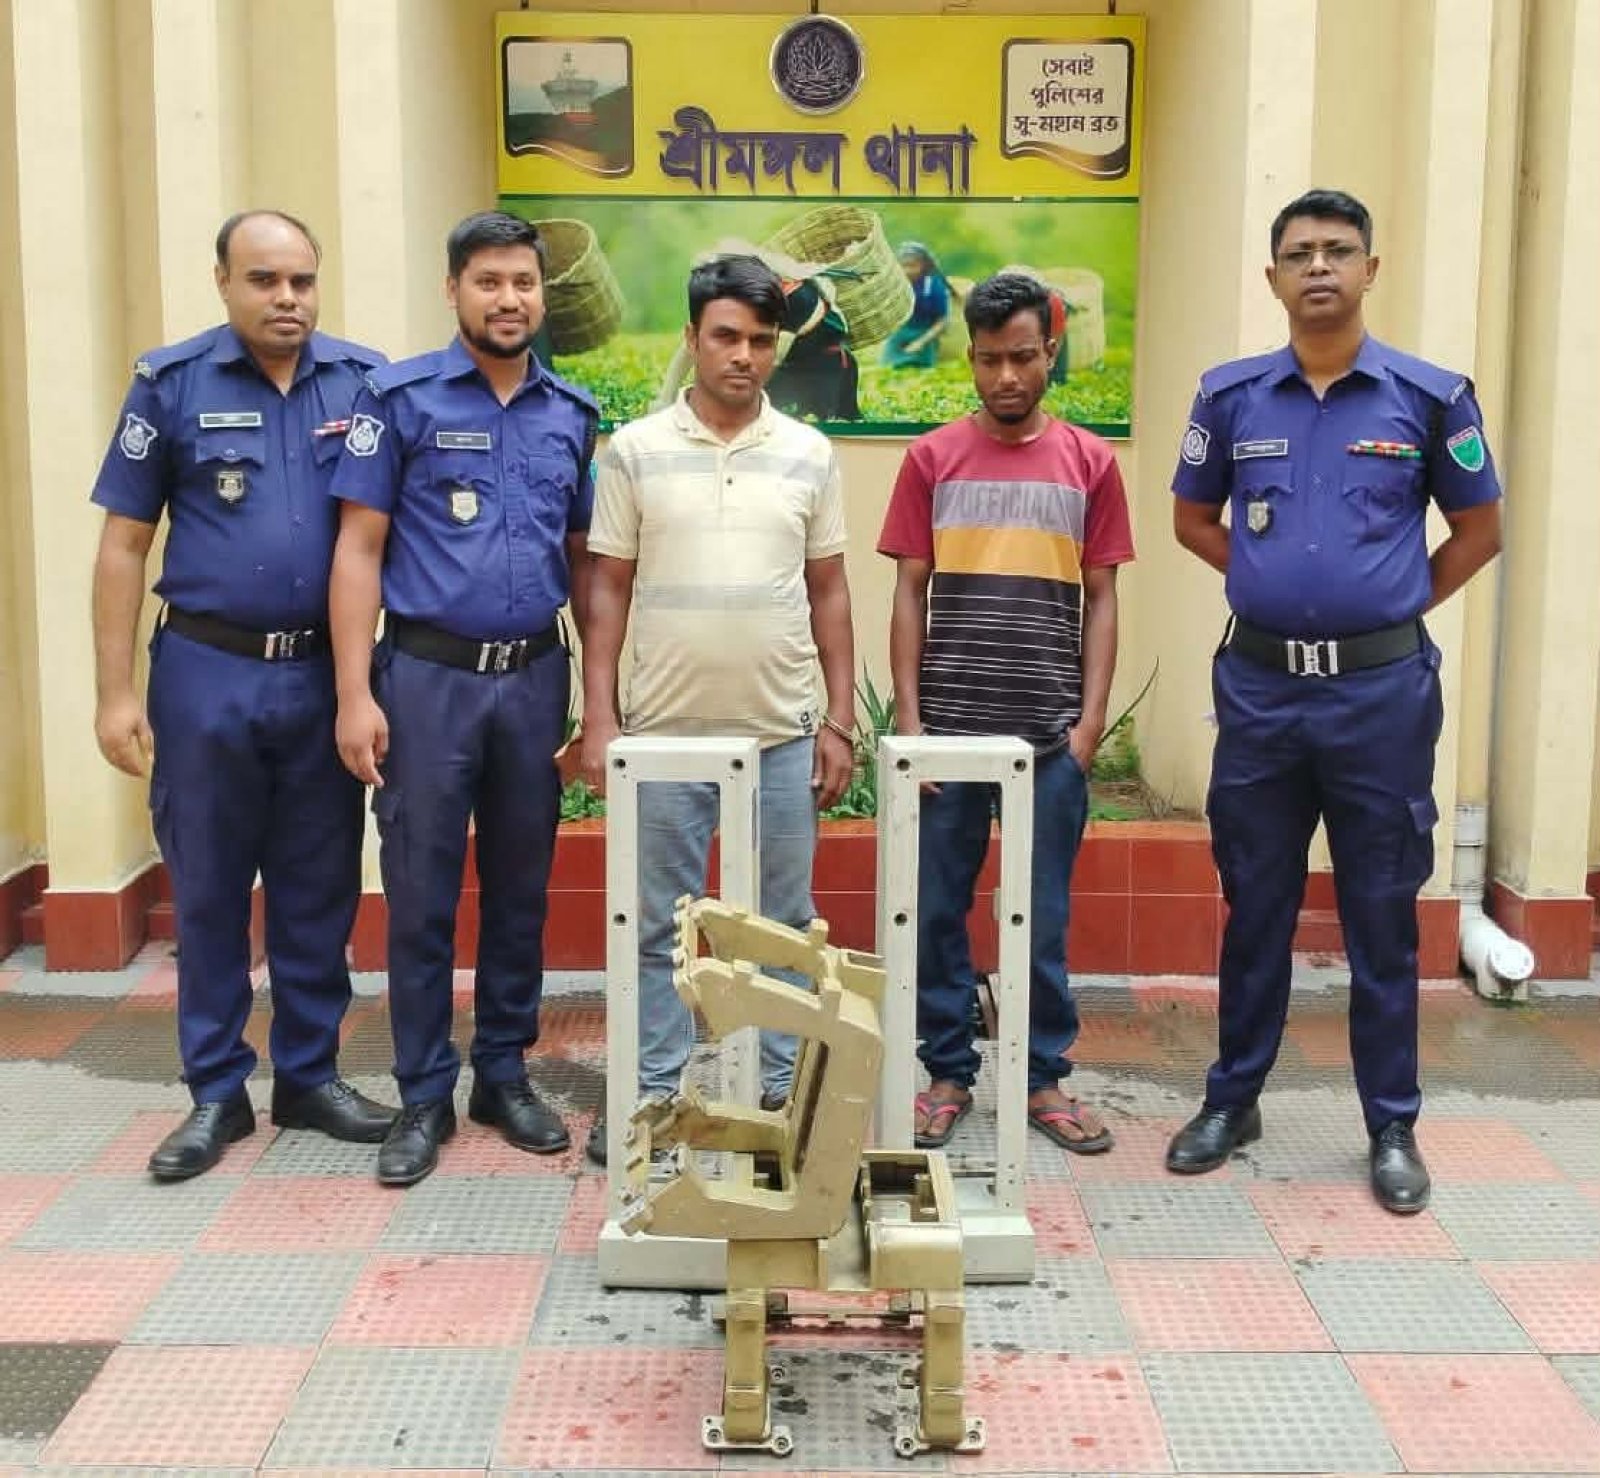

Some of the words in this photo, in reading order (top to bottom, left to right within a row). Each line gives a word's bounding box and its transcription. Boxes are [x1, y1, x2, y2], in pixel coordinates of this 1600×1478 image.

[1042, 52, 1094, 77] সেবাই
[1030, 80, 1104, 109] পুলিশের
[1012, 115, 1085, 137] সু-মহান
[1089, 115, 1123, 133] ব্রত
[656, 105, 848, 195] শ্রীমঙ্গল
[863, 121, 978, 196] থানা
